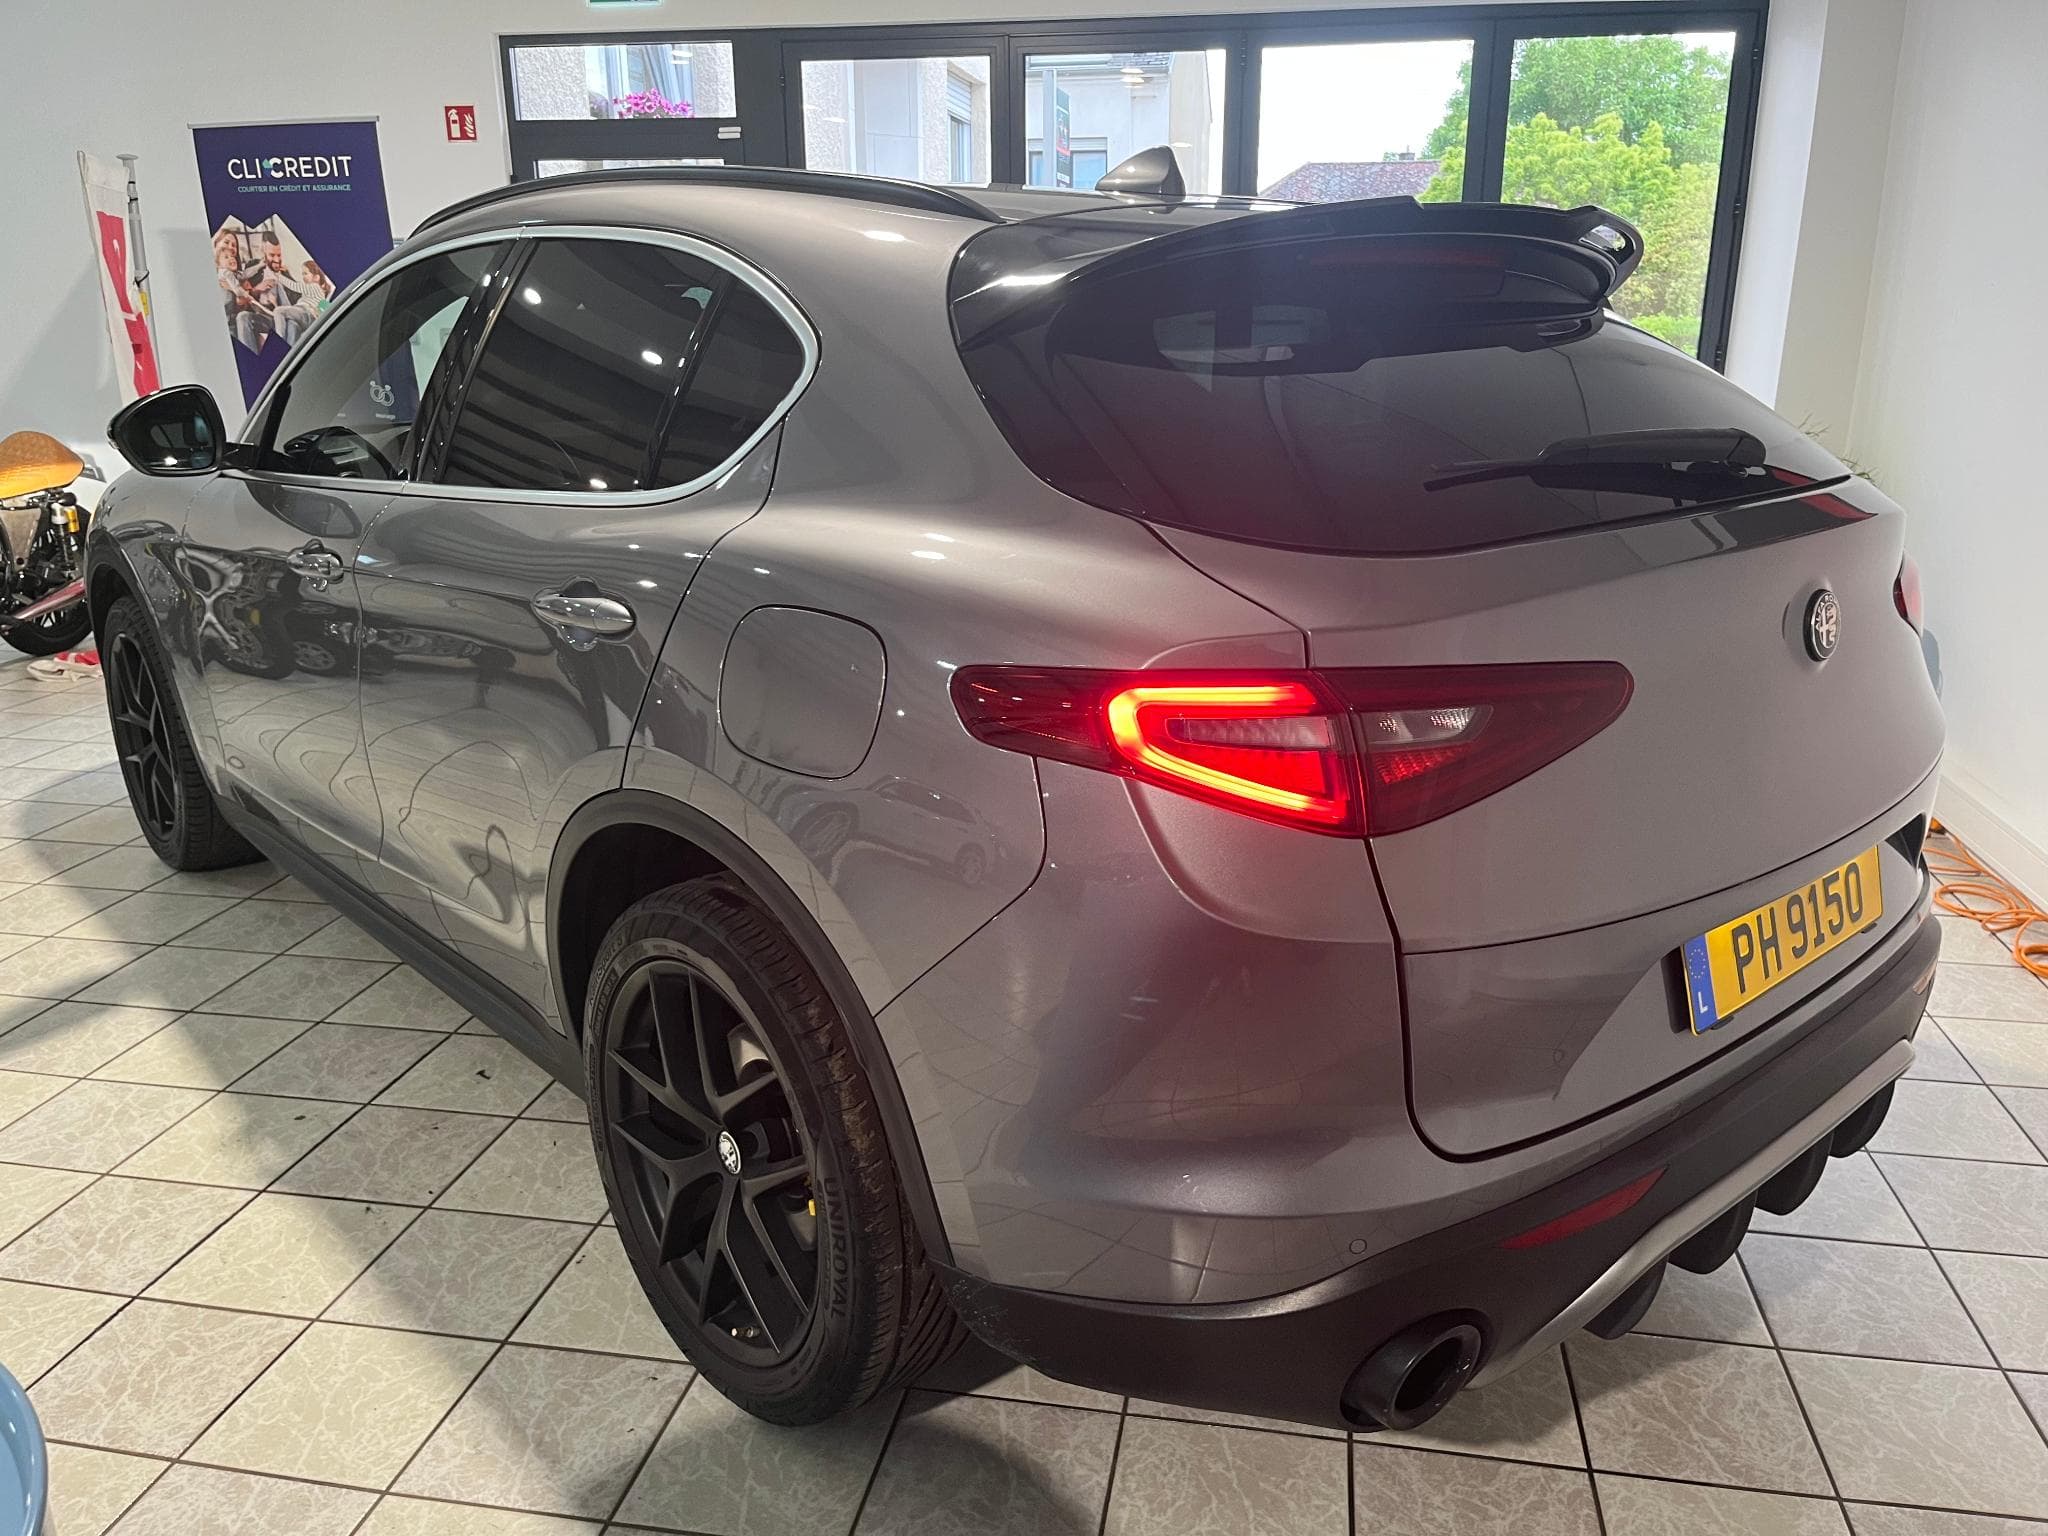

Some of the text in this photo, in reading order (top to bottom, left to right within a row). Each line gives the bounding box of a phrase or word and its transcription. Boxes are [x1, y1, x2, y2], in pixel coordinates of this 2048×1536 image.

[237, 185, 268, 193] COURTIER
[302, 184, 311, 192] ET
[1731, 861, 1864, 994] PH 9150
[1697, 991, 1709, 1014] L
[823, 1176, 848, 1320] UNIROYAL
